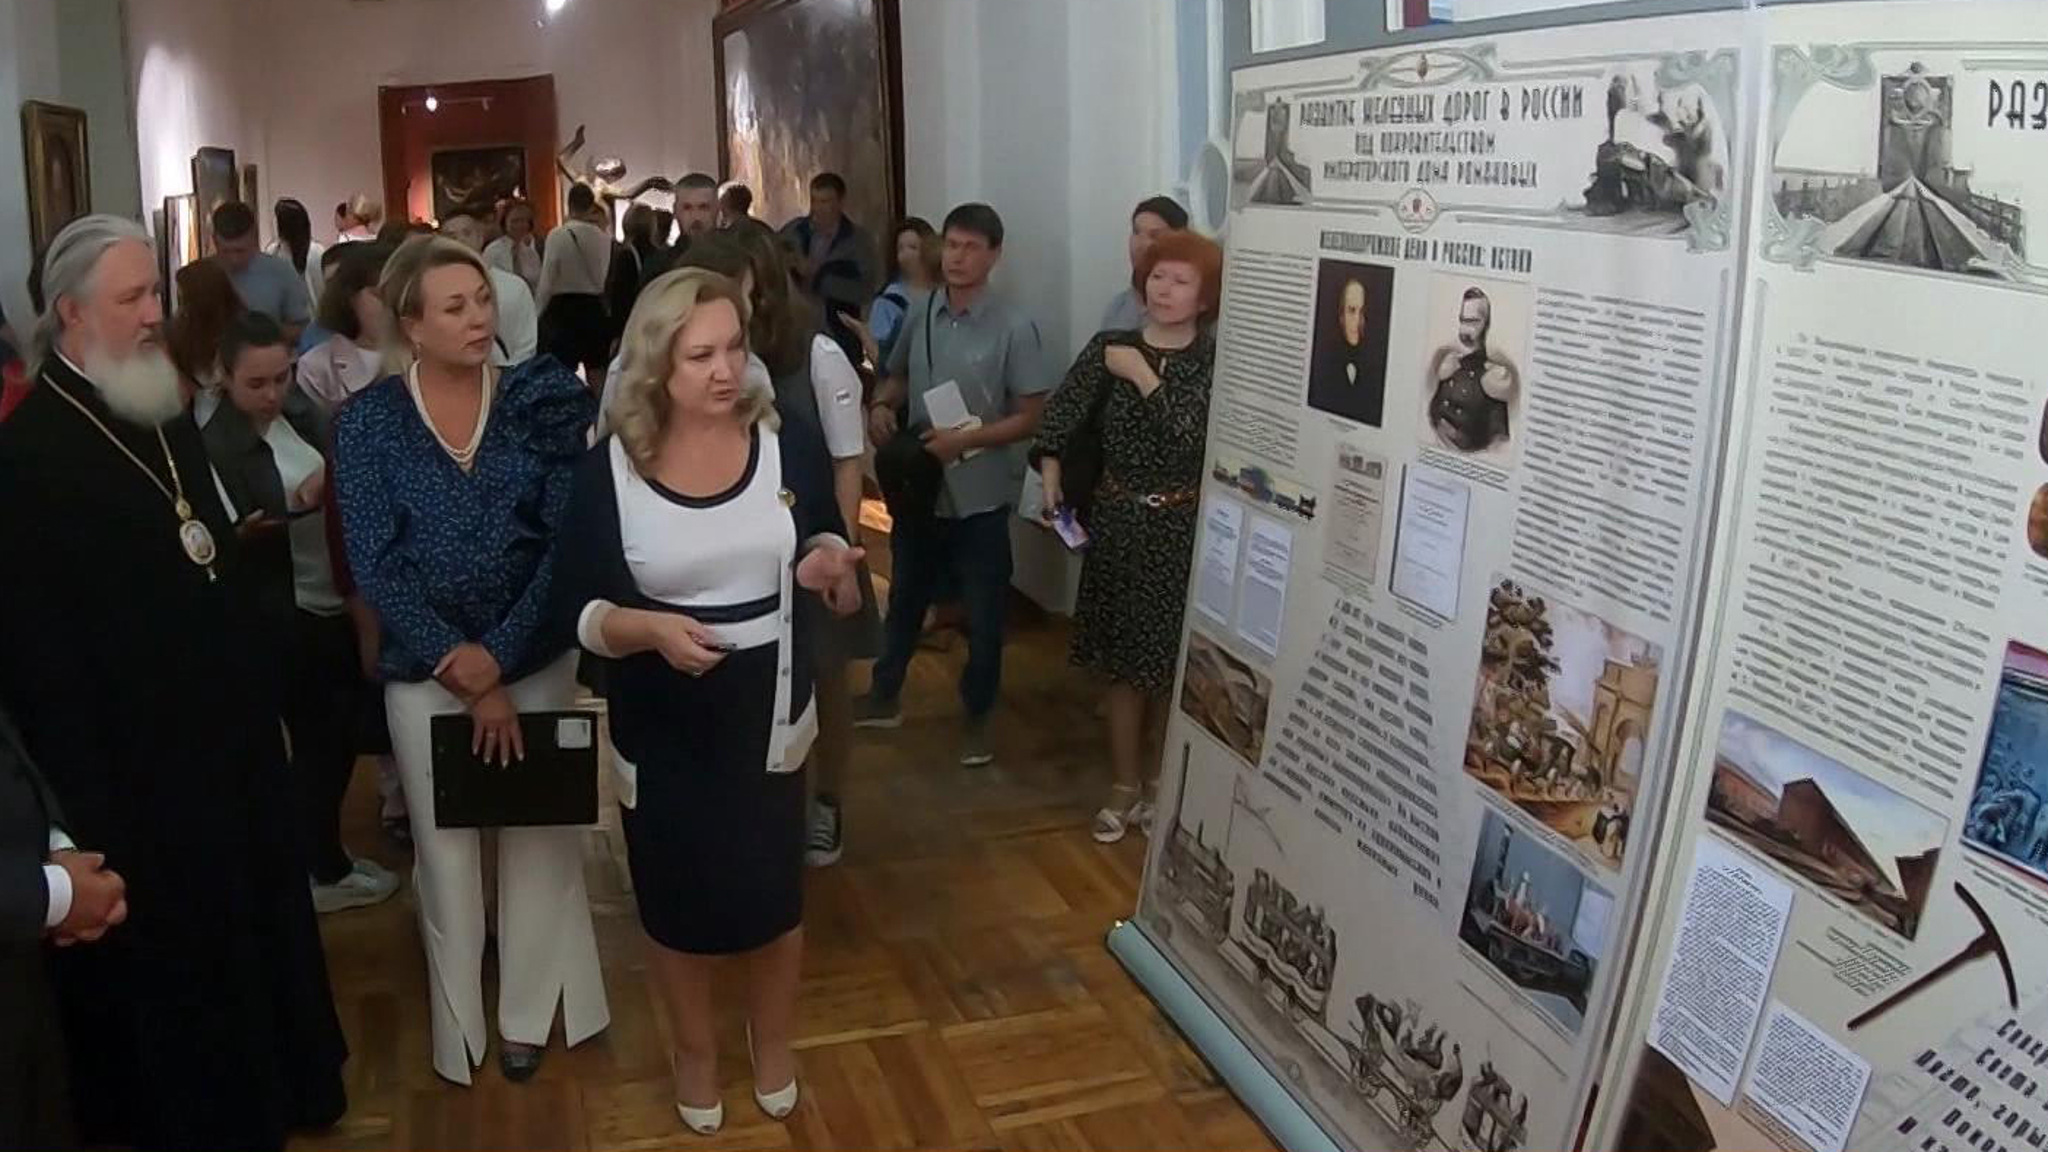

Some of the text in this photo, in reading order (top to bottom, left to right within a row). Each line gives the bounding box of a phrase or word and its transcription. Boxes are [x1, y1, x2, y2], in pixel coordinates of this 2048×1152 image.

[1442, 90, 1490, 125] ДОРОГ
[1500, 88, 1510, 121] В
[1522, 85, 1583, 121] РОССИИ
